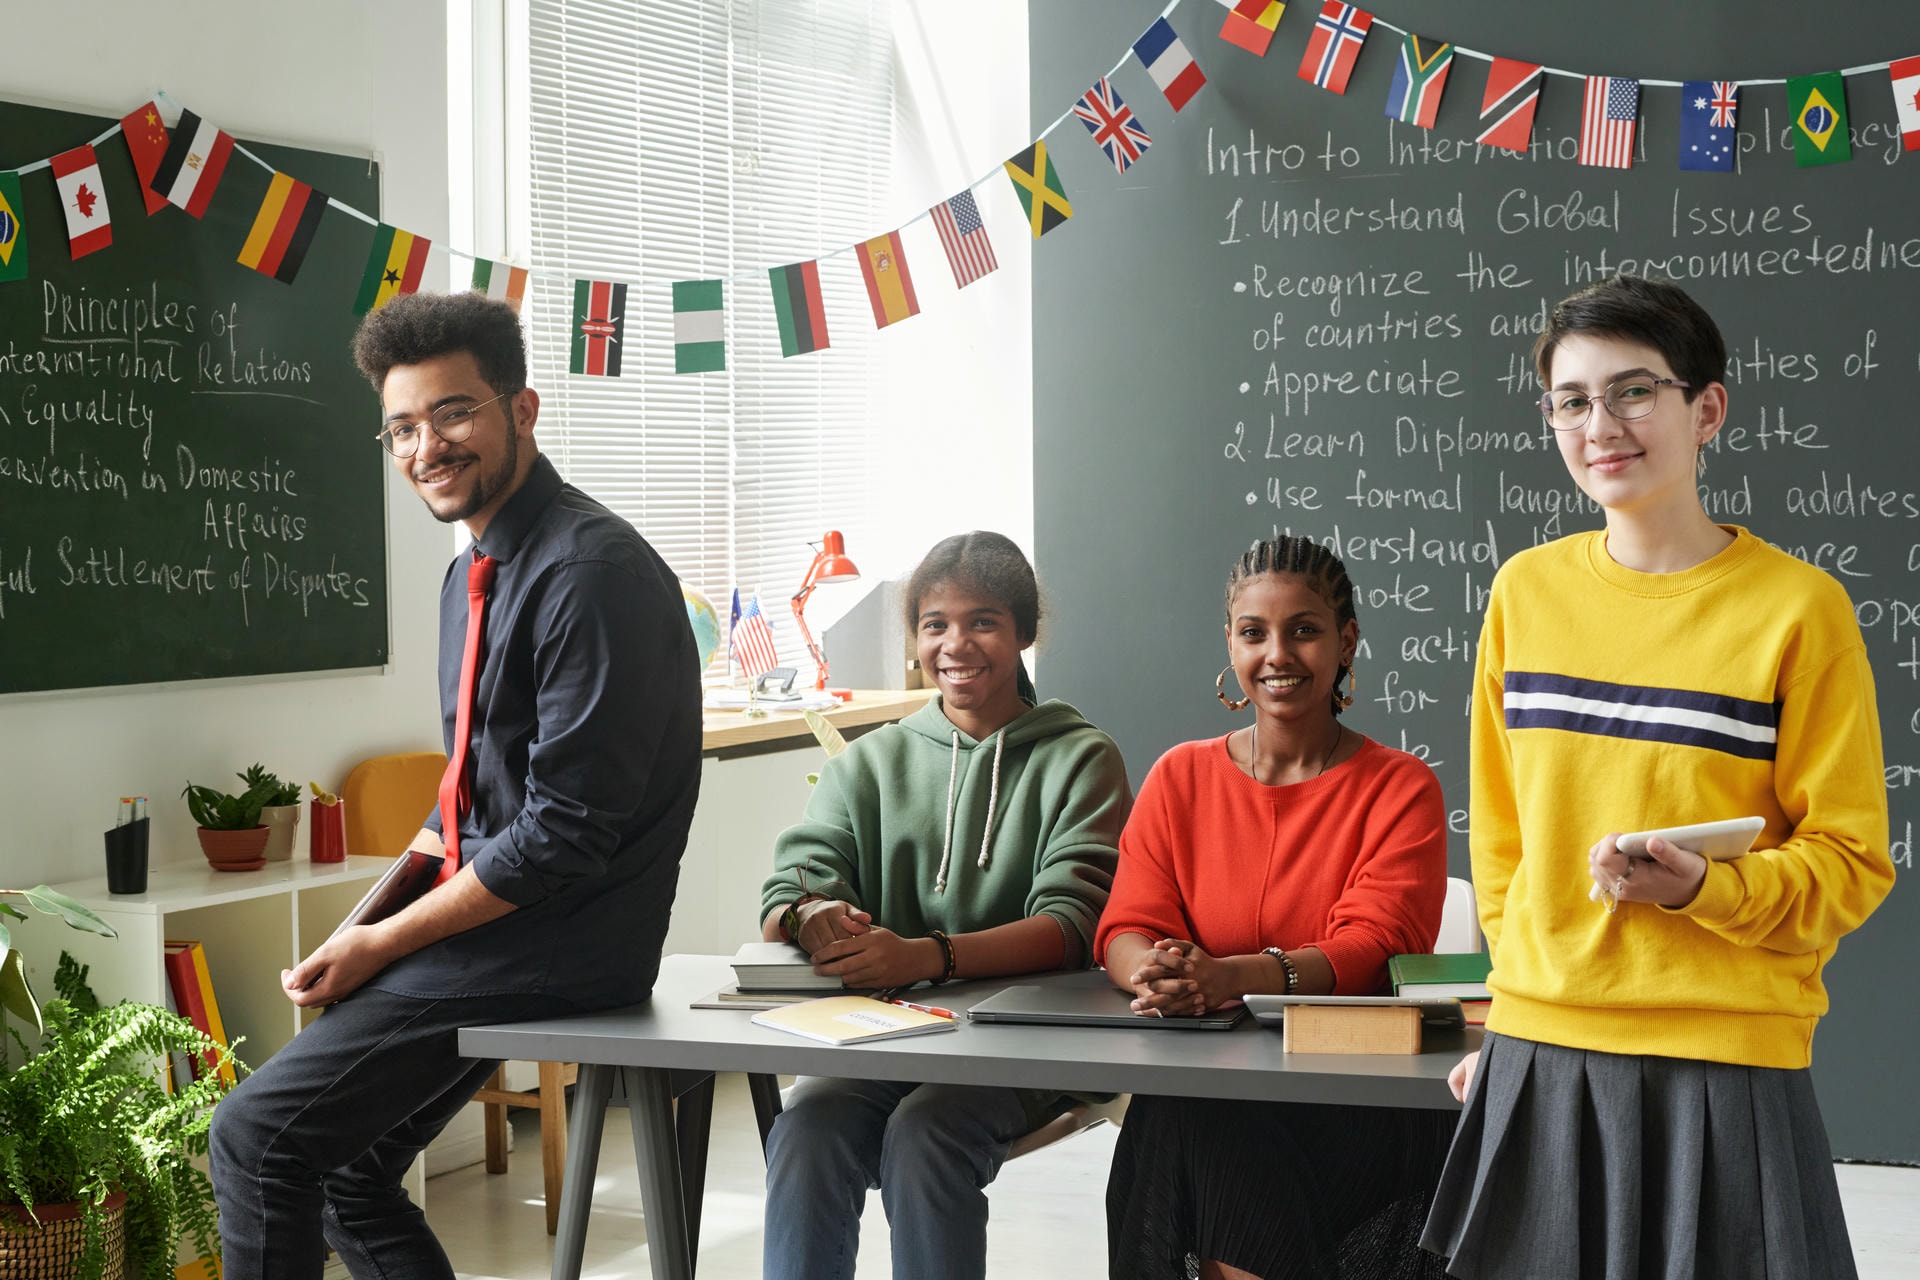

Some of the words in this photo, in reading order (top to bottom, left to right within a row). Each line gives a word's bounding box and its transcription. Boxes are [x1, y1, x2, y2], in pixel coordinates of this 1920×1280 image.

[1208, 127, 1305, 176] Intro
[1317, 130, 1360, 171] to
[1261, 192, 1465, 239] Understand
[1497, 188, 1619, 234] Global
[1672, 188, 1813, 237] Issues
[1254, 264, 1431, 318] Recognize
[1456, 251, 1533, 292] the
[210, 302, 240, 352] of
[1253, 312, 1285, 351] of
[1305, 310, 1463, 349] countries
[1489, 298, 1548, 337] and
[198, 343, 311, 384] Relations
[1263, 357, 1465, 417] Appreciate
[1844, 329, 1879, 380] of
[22, 384, 153, 460] Equality
[1265, 412, 1365, 459] Learn
[142, 457, 167, 492] in
[177, 442, 298, 496] Domestic
[1266, 477, 1323, 510] Use
[1346, 469, 1462, 513] formal
[58, 535, 216, 594] Settlement
[229, 555, 251, 626] of
[264, 551, 369, 617] Disputes
[1375, 671, 1438, 714] for
